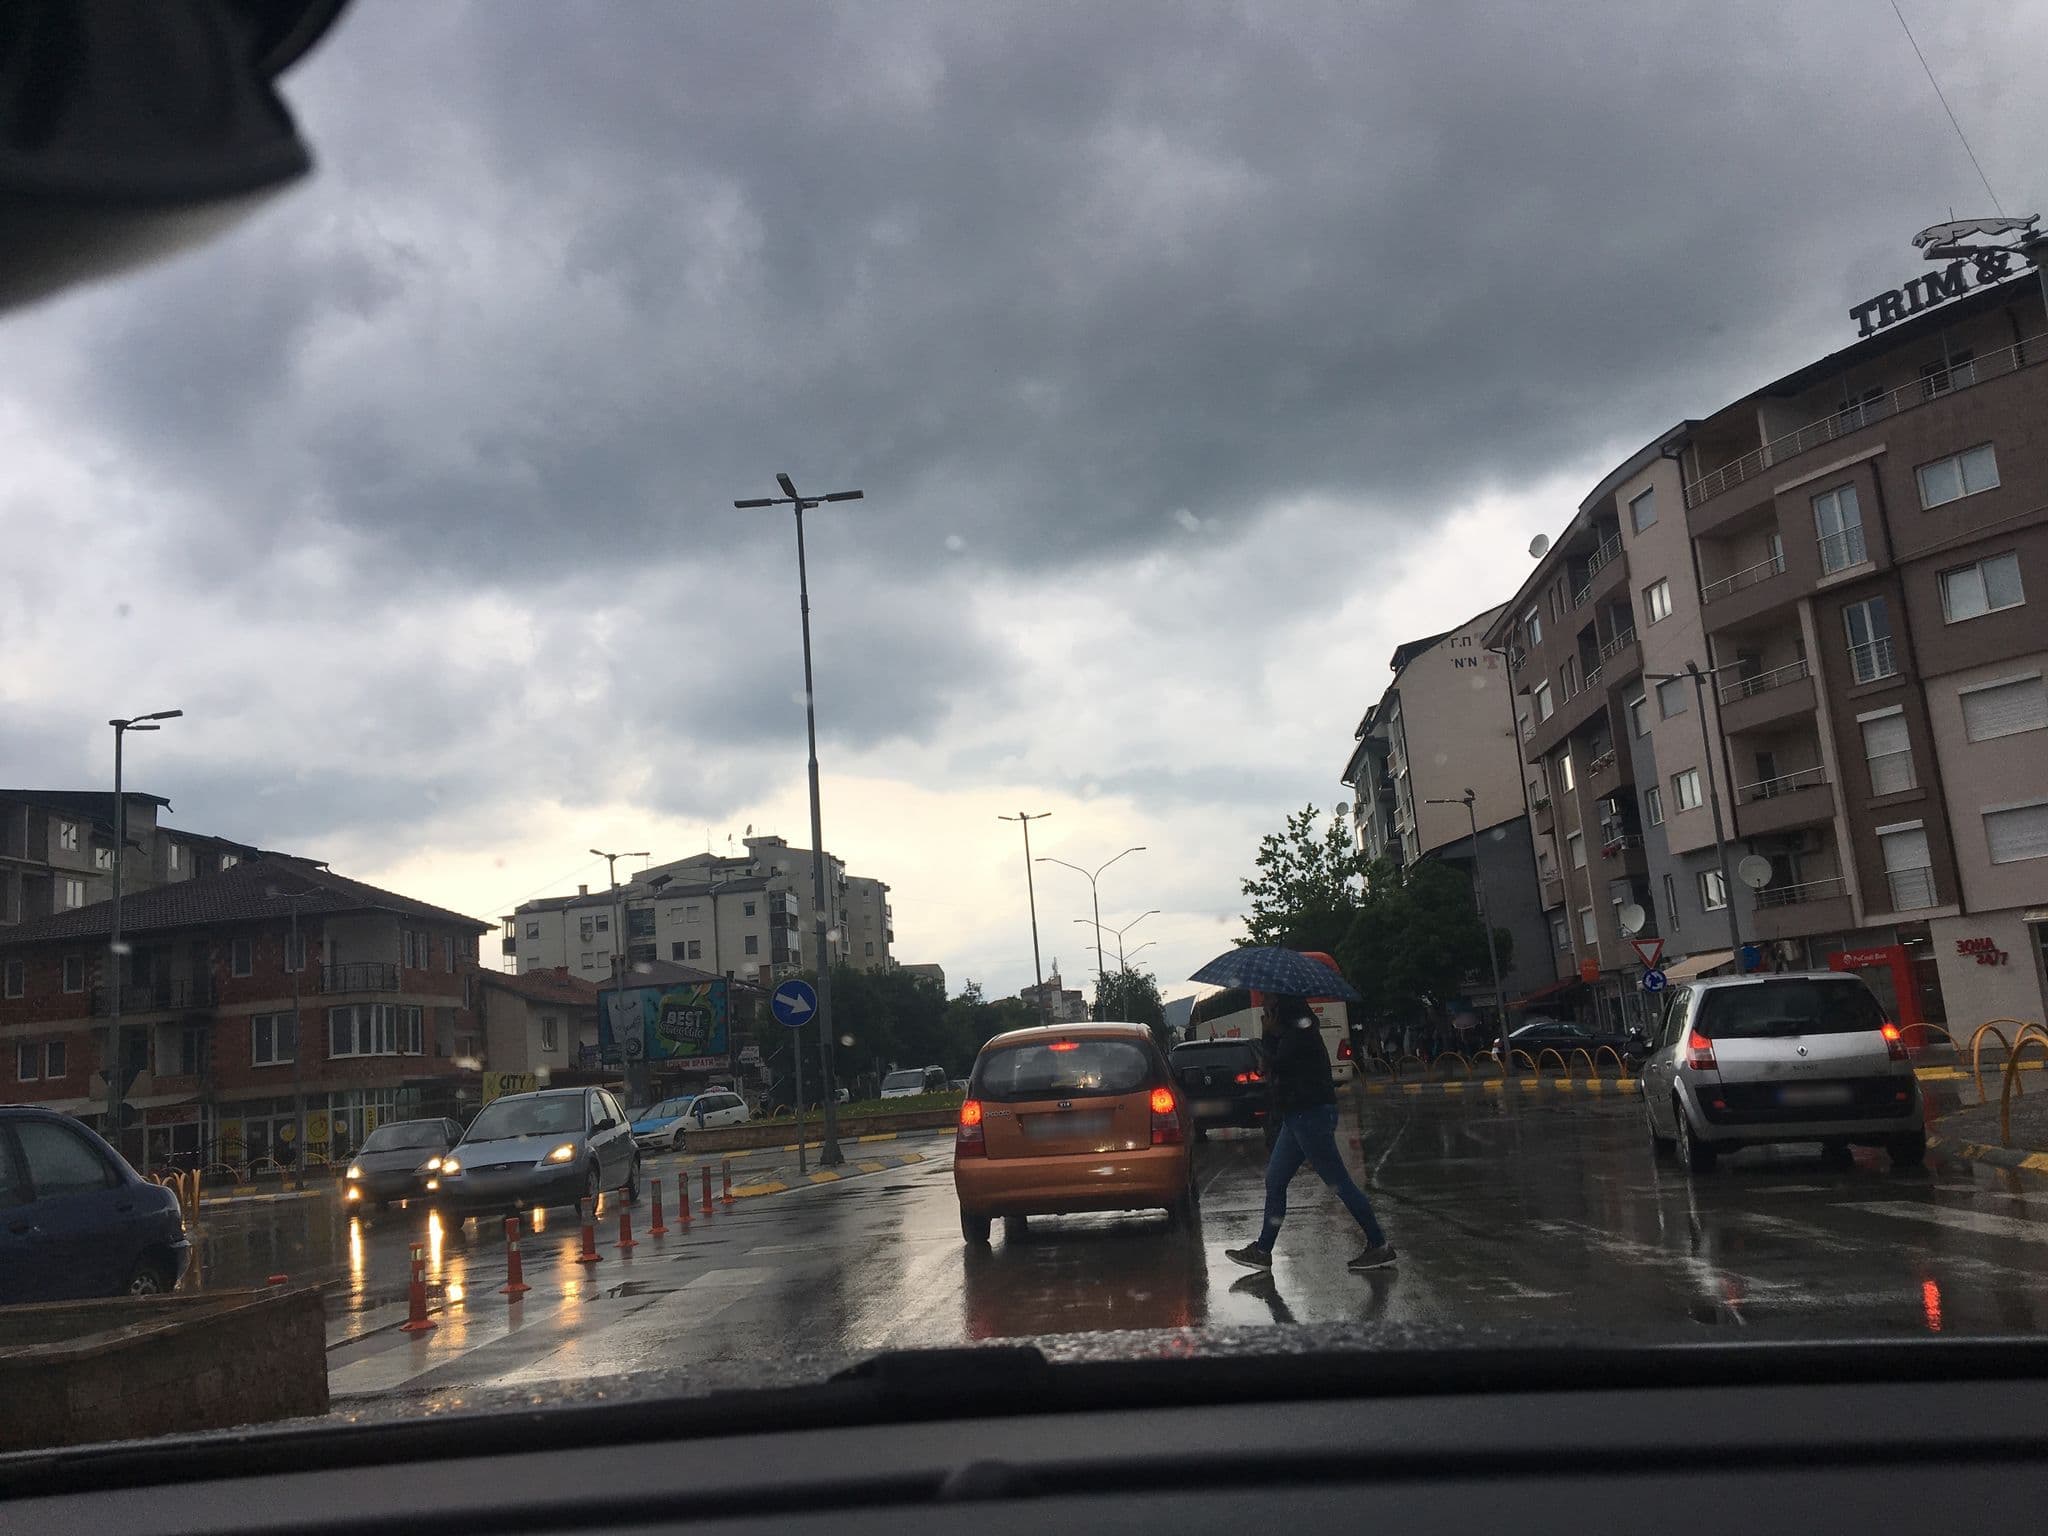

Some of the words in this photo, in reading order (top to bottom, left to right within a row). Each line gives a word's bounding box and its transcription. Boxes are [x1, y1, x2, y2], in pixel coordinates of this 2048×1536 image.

[1849, 260, 1970, 337] TRIM
[1976, 247, 2012, 284] &
[1956, 937, 1995, 954] ЗОНА
[1976, 949, 2009, 967] 24/7
[666, 1010, 703, 1028] BEST
[499, 1075, 526, 1090] CITY
